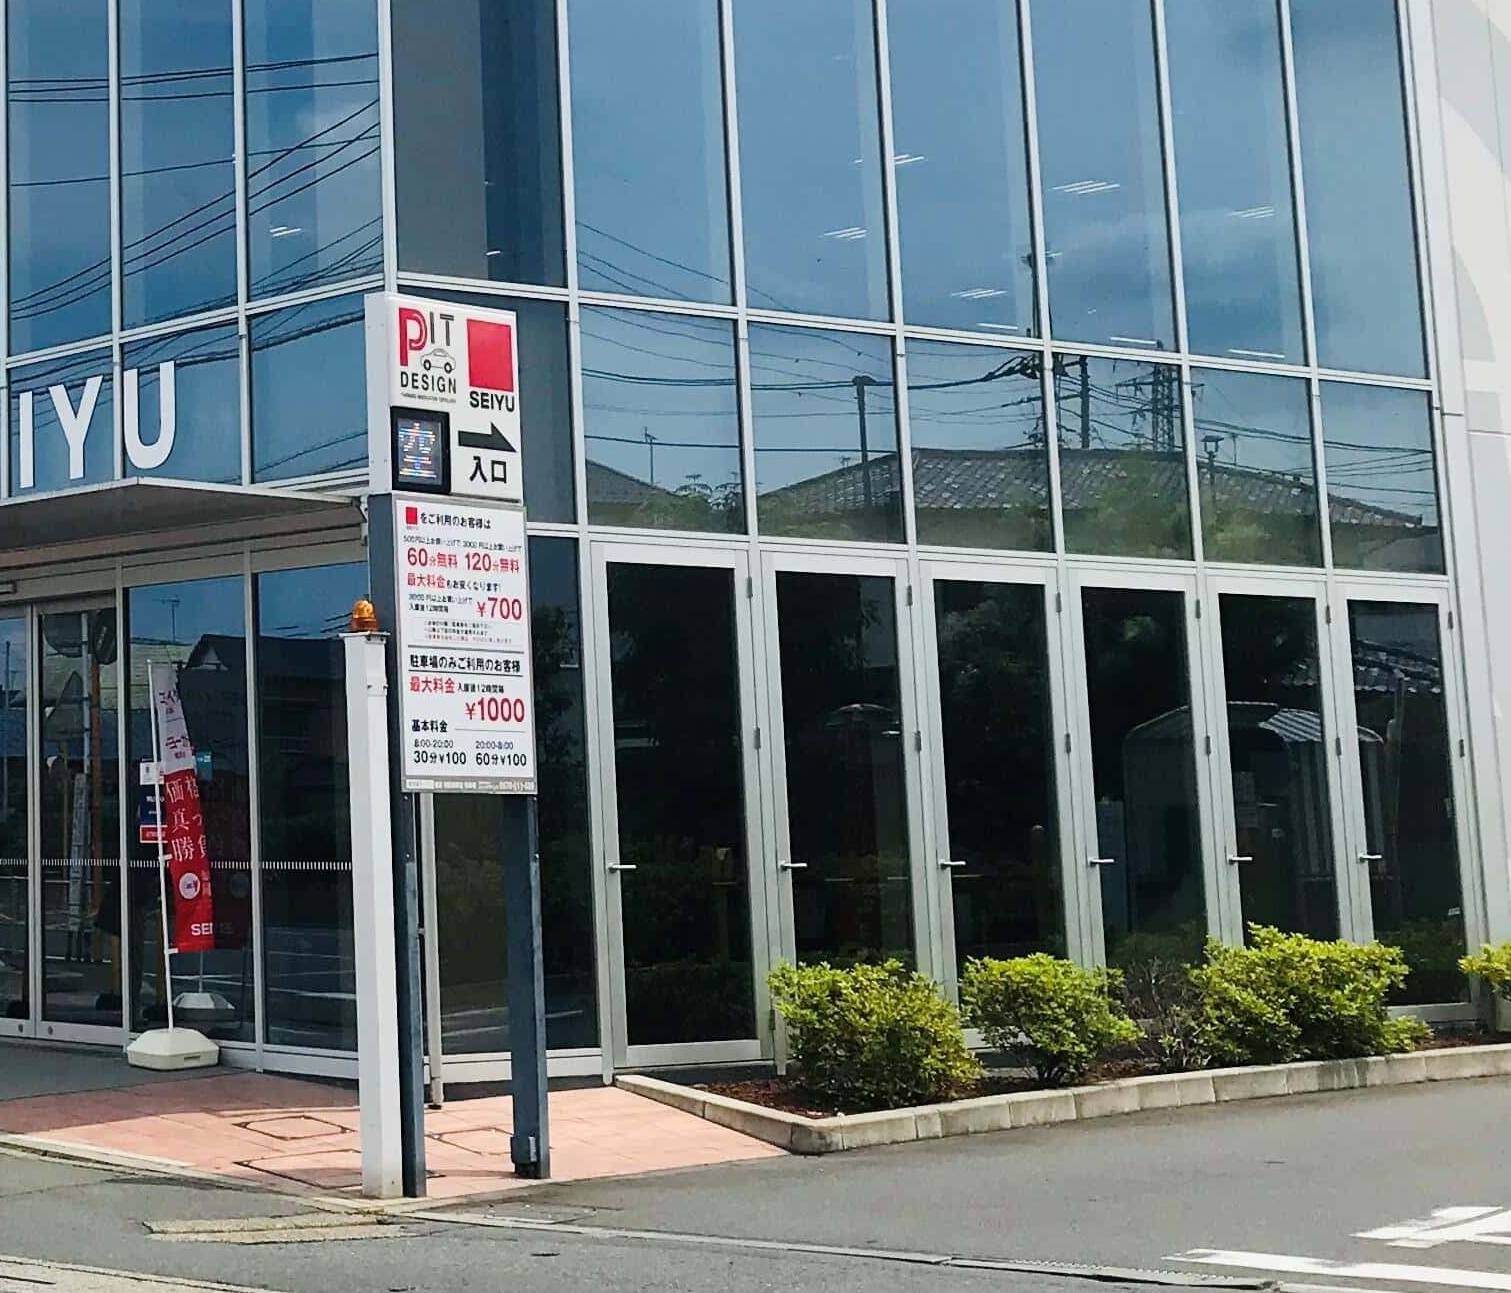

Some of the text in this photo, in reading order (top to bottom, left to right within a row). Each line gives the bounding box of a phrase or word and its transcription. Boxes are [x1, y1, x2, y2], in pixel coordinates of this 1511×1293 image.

[398, 307, 455, 367] PIT
[400, 370, 457, 395] DESIGN
[469, 391, 515, 412] SEIYU
[469, 456, 507, 484] 入口
[420, 512, 492, 530] をご利用のお客様は
[407, 547, 520, 573] 60分無料 120分無料
[476, 596, 522, 621] ¥700
[410, 654, 521, 673] 駐車場のみご利用のお客様
[410, 676, 456, 694] 最大料金
[465, 697, 525, 723] ¥1000
[411, 719, 448, 733] 基本料金
[413, 750, 527, 767] 30分¥100 60分¥100
